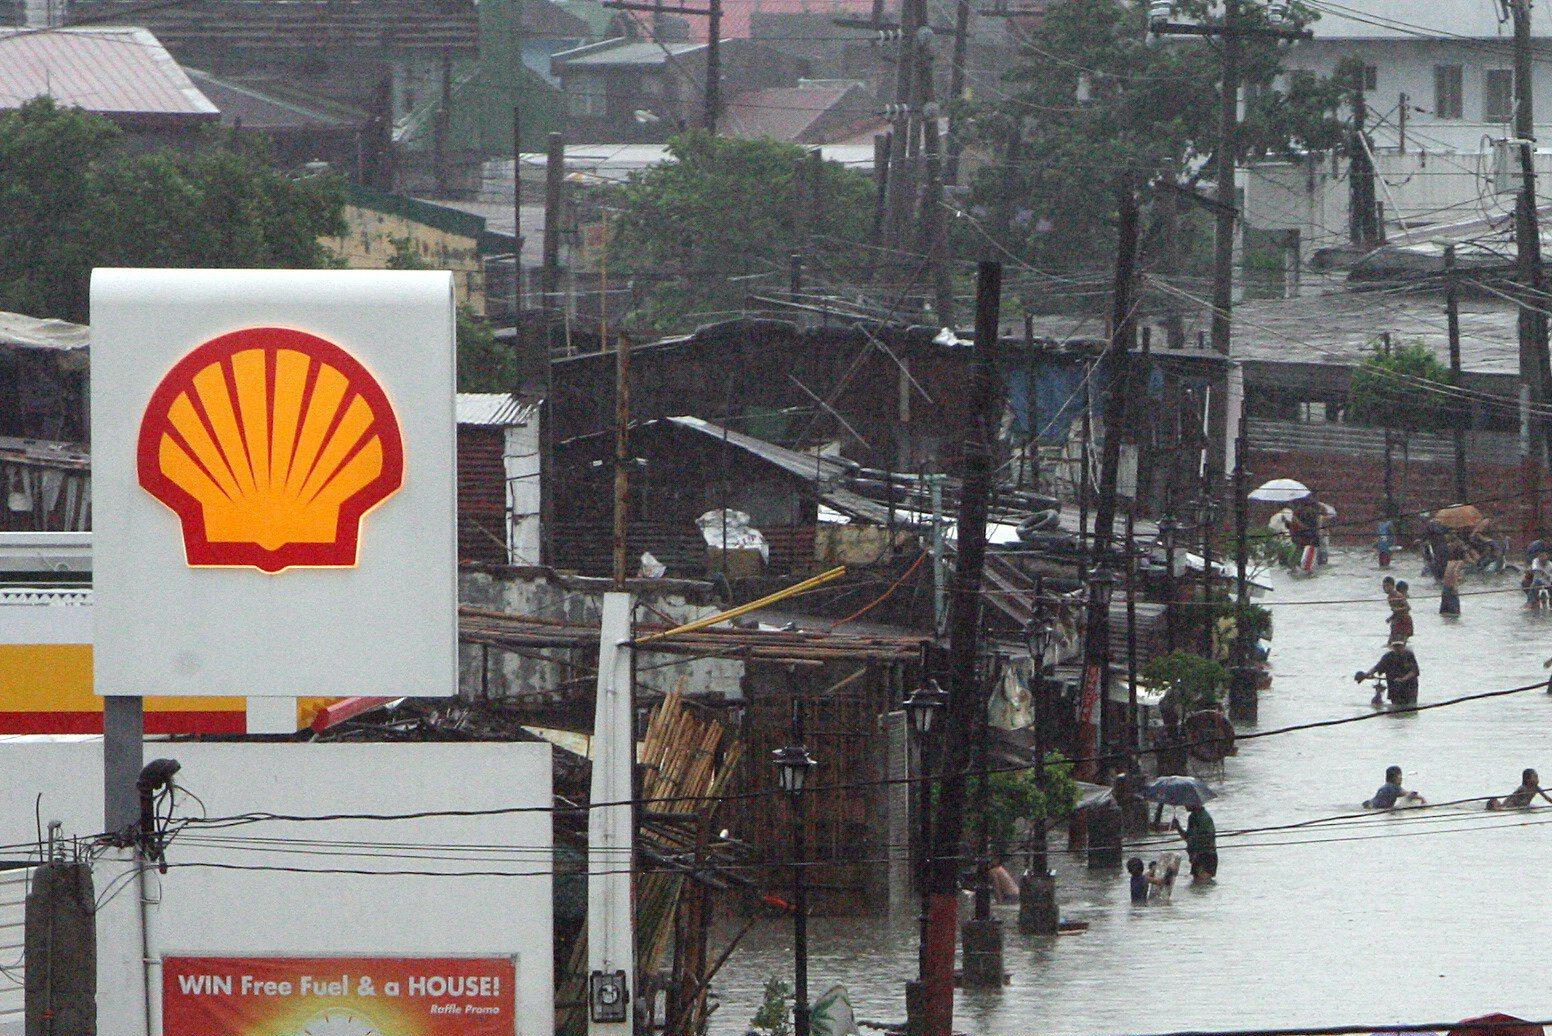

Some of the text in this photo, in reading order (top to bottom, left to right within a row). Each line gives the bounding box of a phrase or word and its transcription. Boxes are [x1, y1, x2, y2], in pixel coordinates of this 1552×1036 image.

[178, 974, 501, 997] WIN Free Fuel & a HOUSE!
[430, 1003, 500, 1016] Raffle Promo
